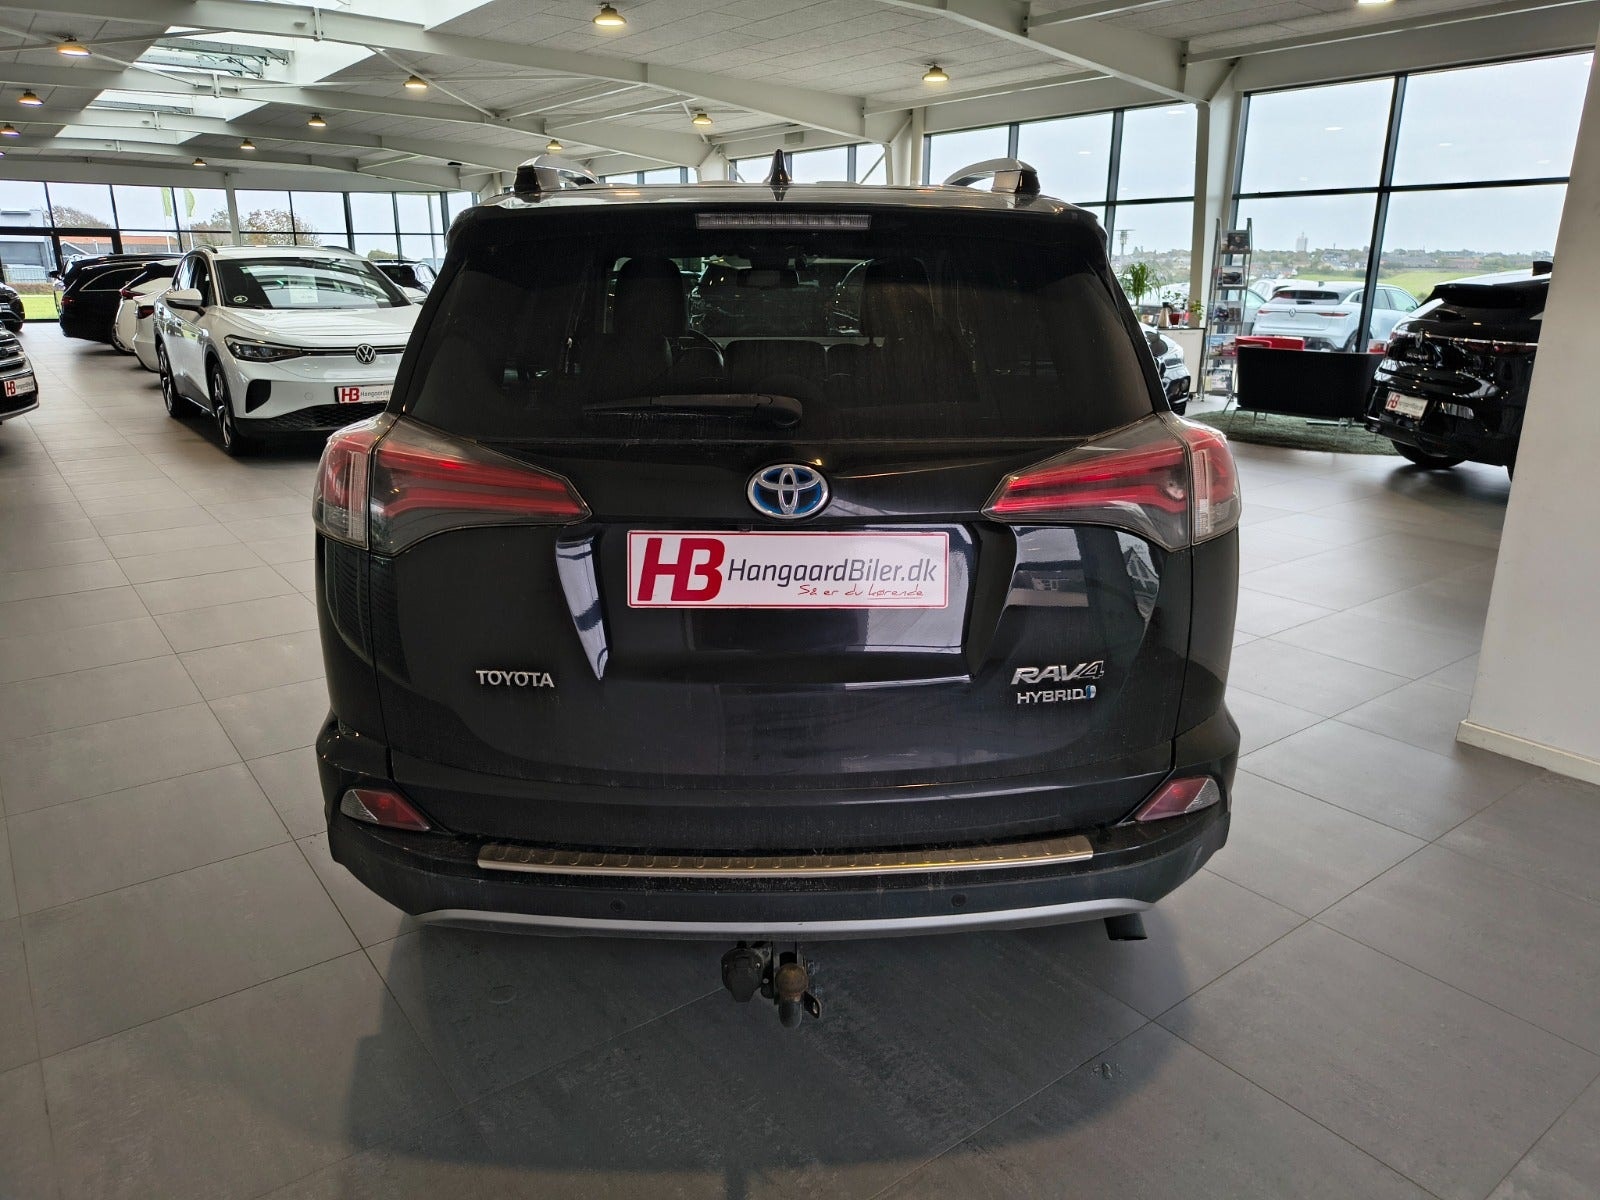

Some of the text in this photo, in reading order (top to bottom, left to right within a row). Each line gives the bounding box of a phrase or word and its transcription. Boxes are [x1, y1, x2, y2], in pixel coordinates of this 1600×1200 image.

[6, 381, 16, 395] HB
[341, 388, 360, 402] HB
[637, 537, 937, 602] HB HangaardBiler.dk
[844, 584, 864, 596] du
[475, 670, 555, 688] TOYOTA
[1011, 660, 1104, 685] RAV4
[1017, 688, 1087, 705] HYBRID
